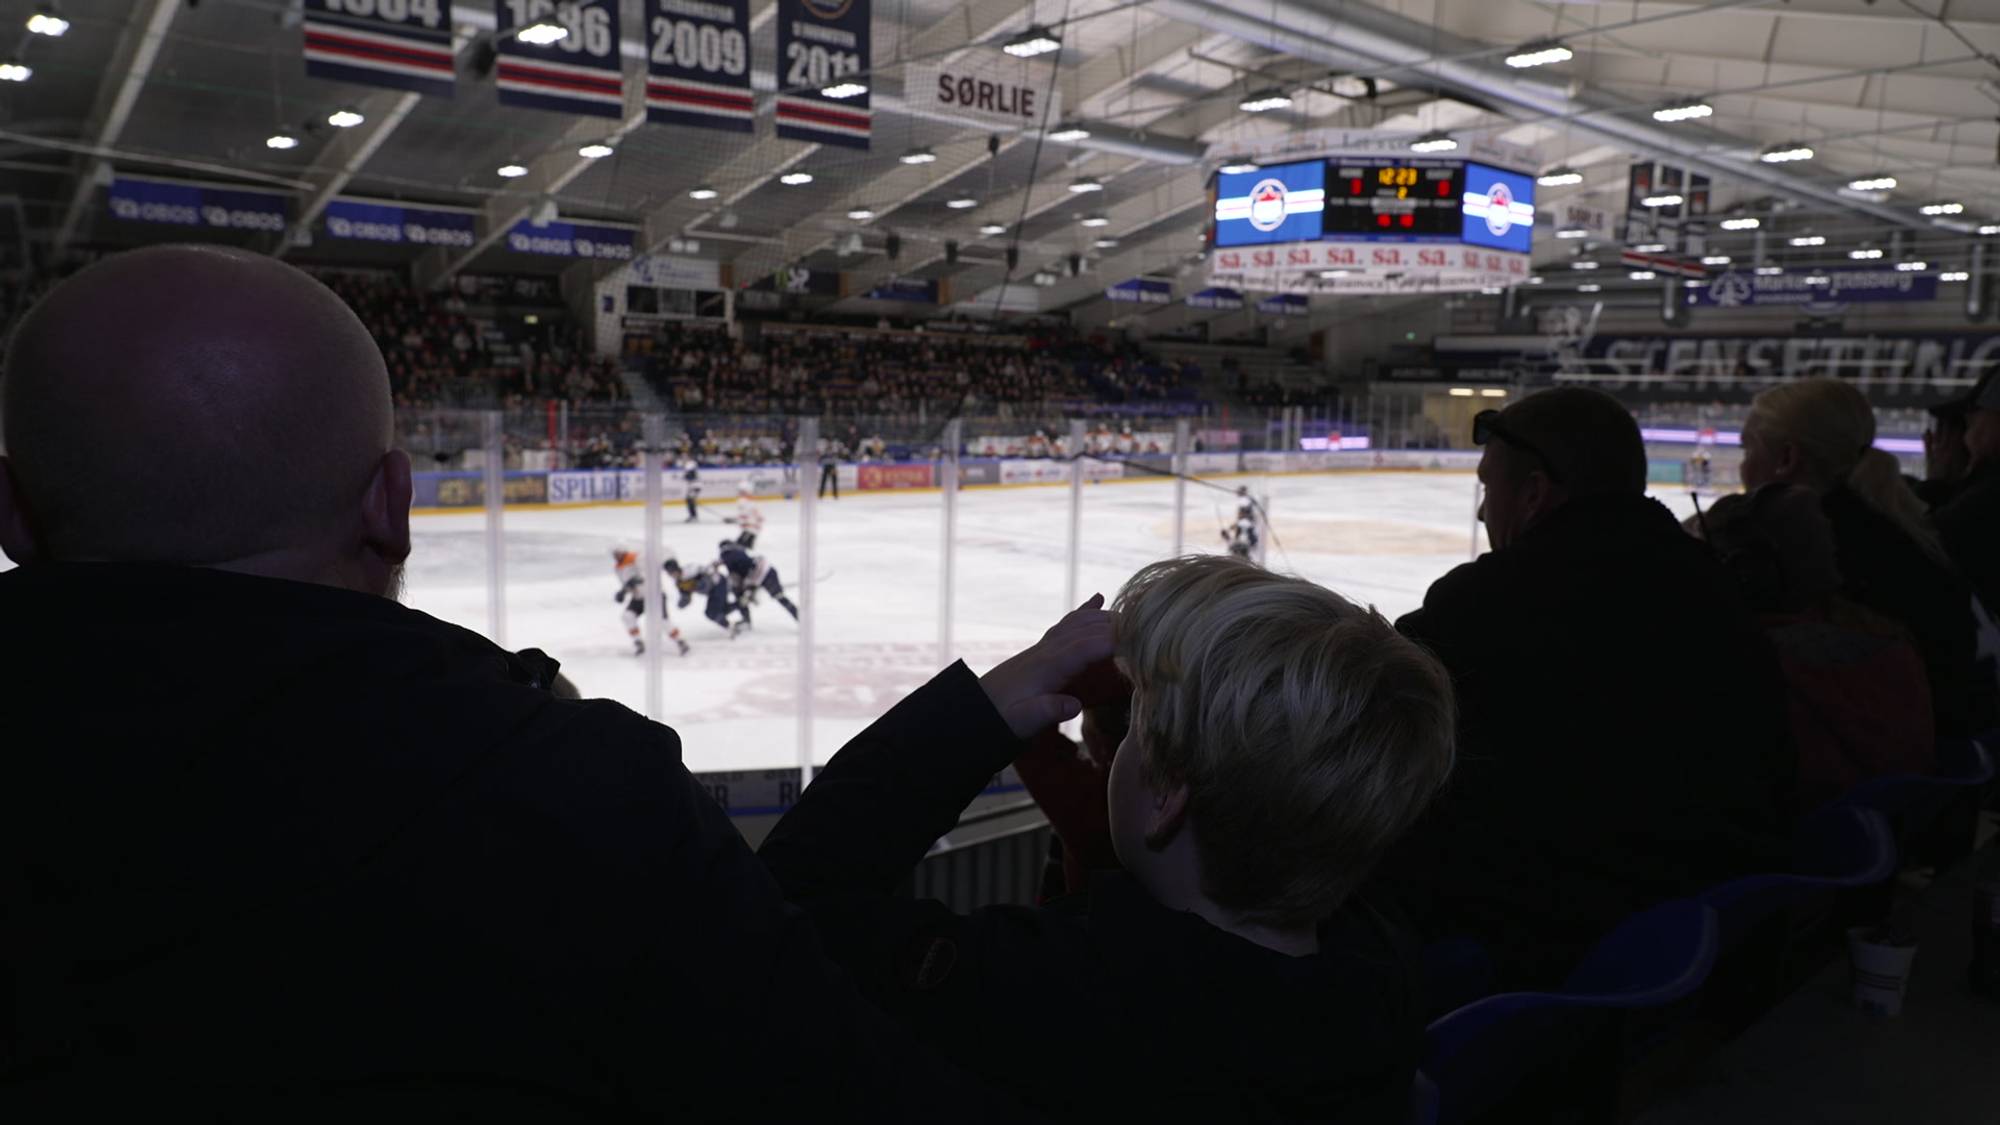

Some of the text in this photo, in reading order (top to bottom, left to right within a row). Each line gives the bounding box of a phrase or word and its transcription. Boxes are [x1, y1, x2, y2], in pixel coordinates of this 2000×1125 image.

[651, 17, 745, 75] 2009
[938, 74, 1034, 117] SØRLIE
[140, 204, 285, 230] OBOS OBOS
[352, 221, 474, 246] OBOS OBOS
[531, 236, 573, 255] OBOS
